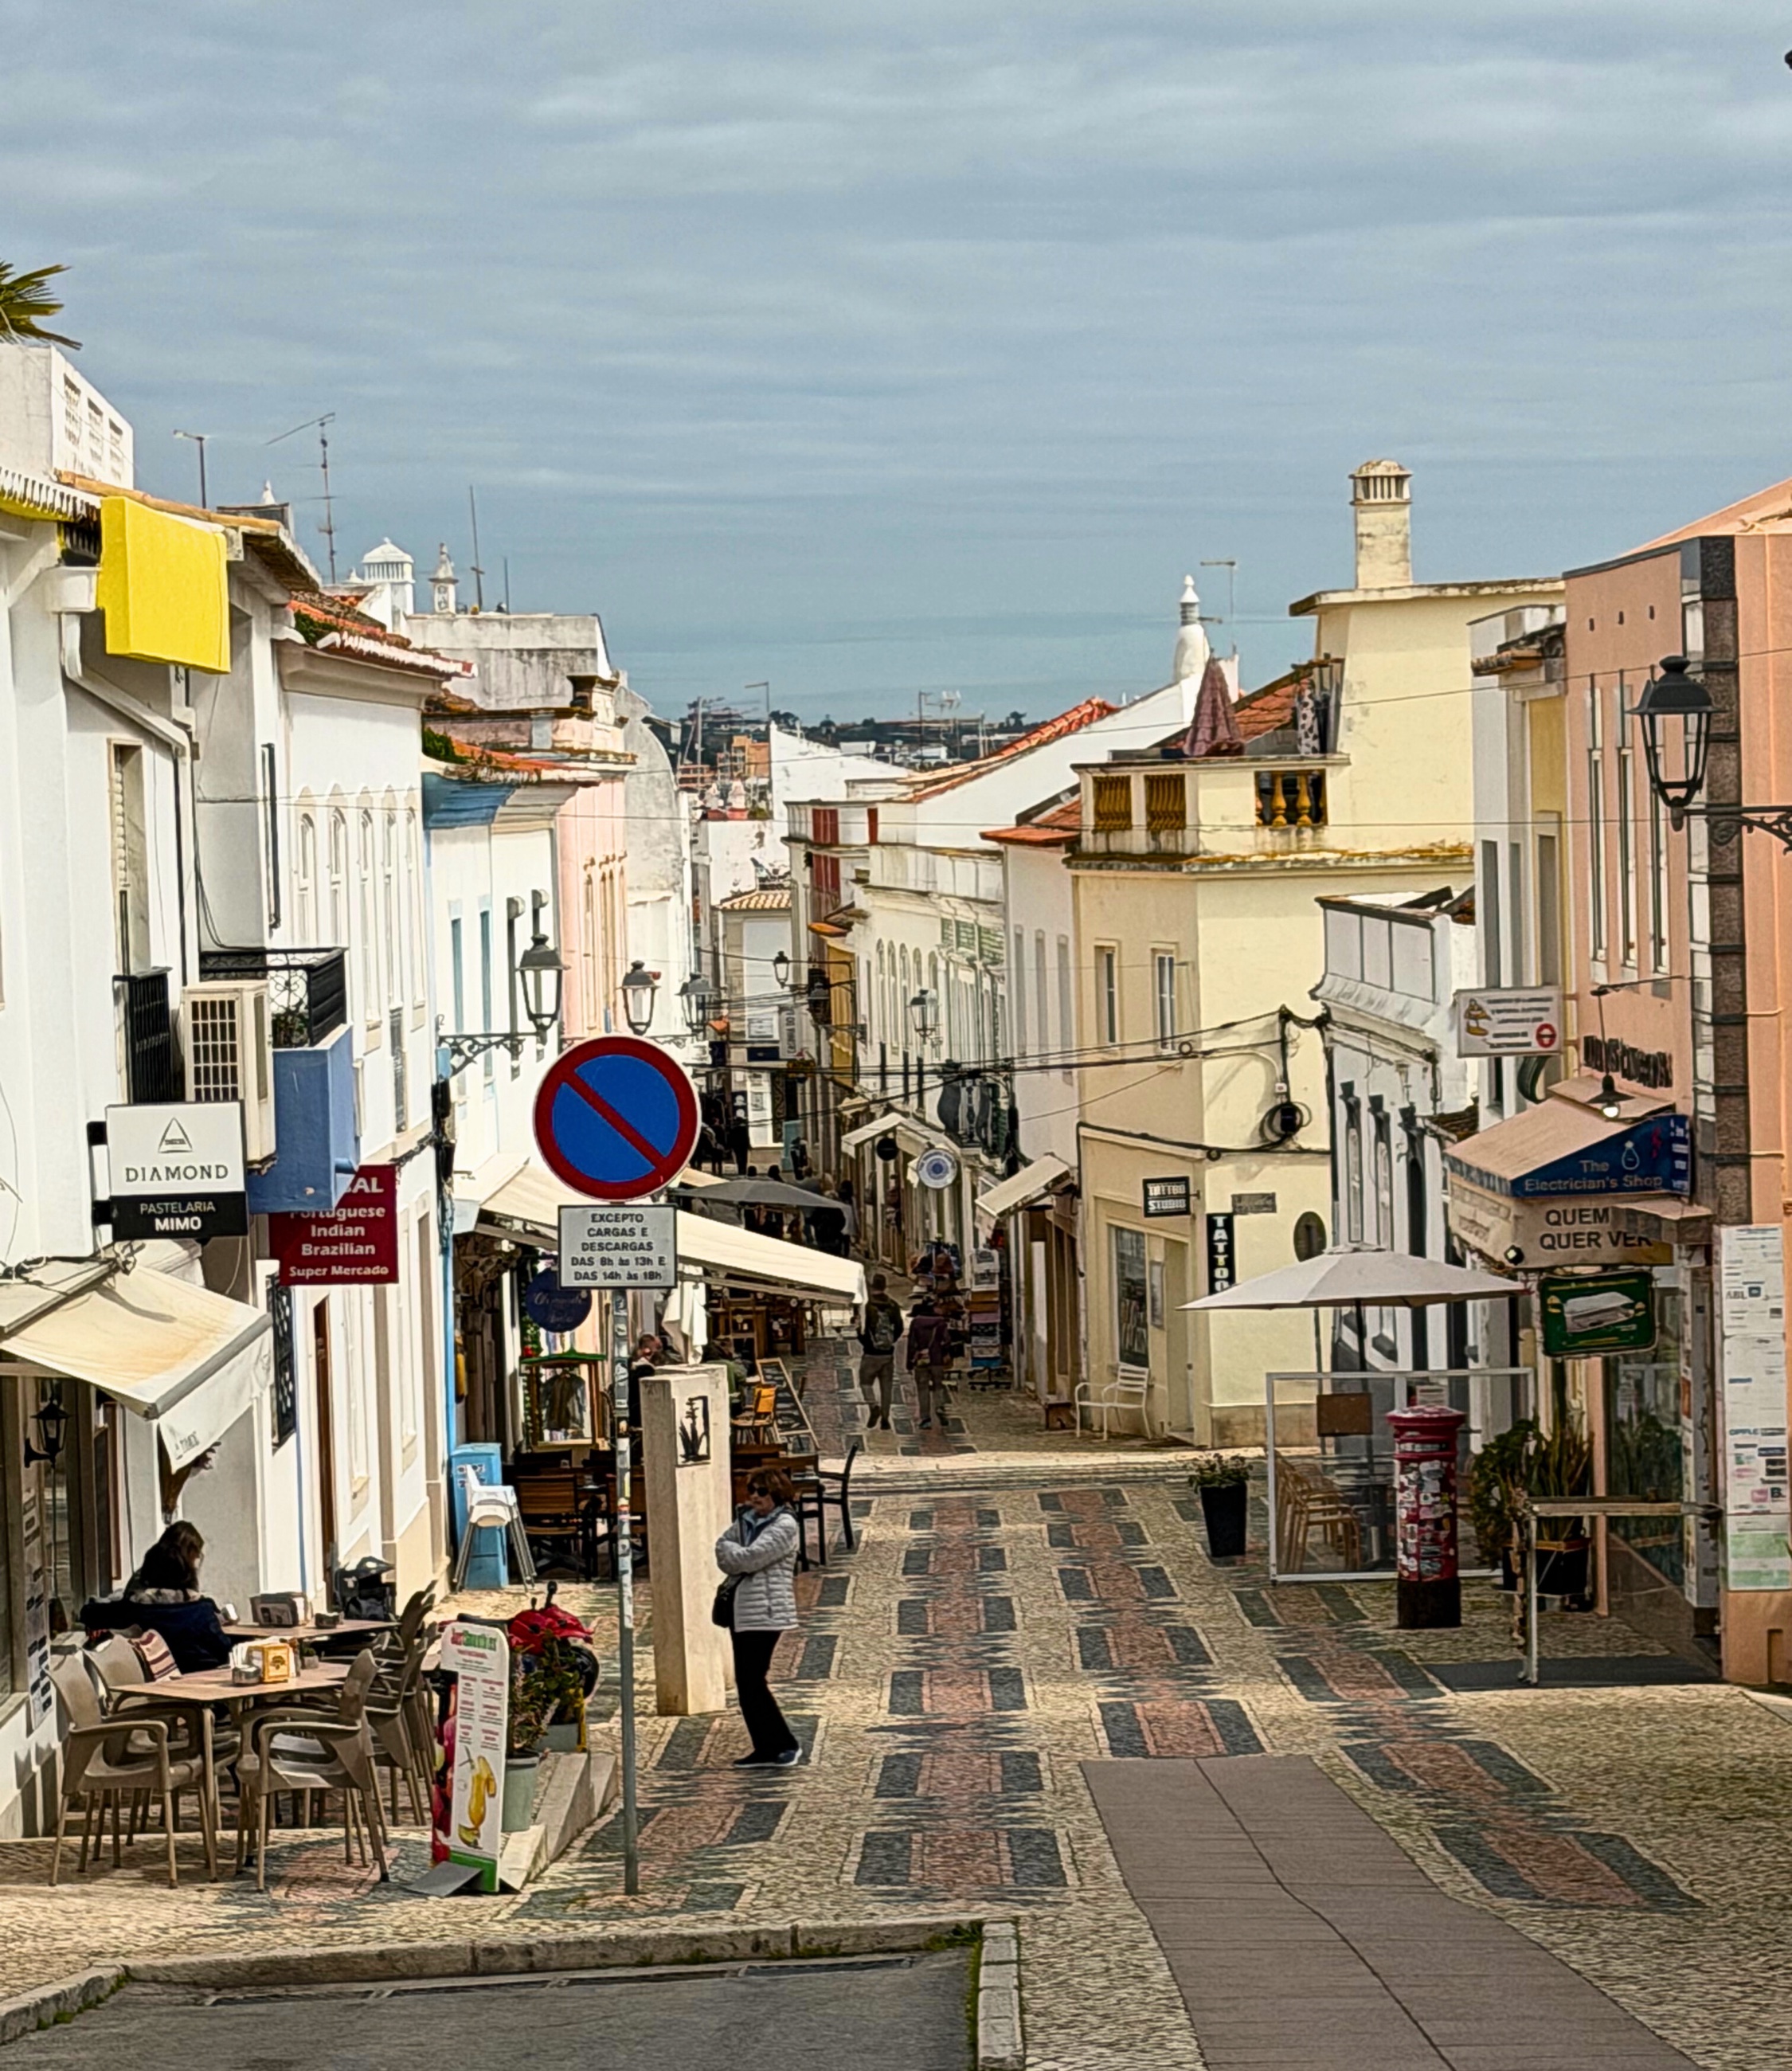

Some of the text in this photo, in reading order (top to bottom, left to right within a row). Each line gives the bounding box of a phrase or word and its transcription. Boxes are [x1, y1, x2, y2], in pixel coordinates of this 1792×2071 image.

[1579, 1160, 1610, 1173] The
[125, 1165, 229, 1182] DIAMOND
[1147, 1184, 1186, 1196] TATTOO
[1524, 1176, 1618, 1192] Electrician's
[1622, 1175, 1663, 1189] Shop
[139, 1201, 216, 1215] PASTELARIA
[1148, 1199, 1187, 1210] STUDIO
[155, 1216, 202, 1231] MIMO
[591, 1213, 644, 1223] EXCEPTO
[1545, 1208, 1610, 1226] QUEM
[311, 1224, 366, 1237] Indian
[587, 1227, 648, 1237] CARGAS E
[581, 1241, 654, 1251] DESCARGAS
[1540, 1231, 1602, 1251] QUER
[301, 1243, 376, 1256] Brazilian
[570, 1256, 595, 1266] DAS
[600, 1256, 614, 1266] 8h
[635, 1256, 653, 1266] 13h
[659, 1256, 666, 1266] E
[289, 1265, 389, 1280] Super Mercado
[573, 1270, 662, 1281] DAS 14h às 18h
